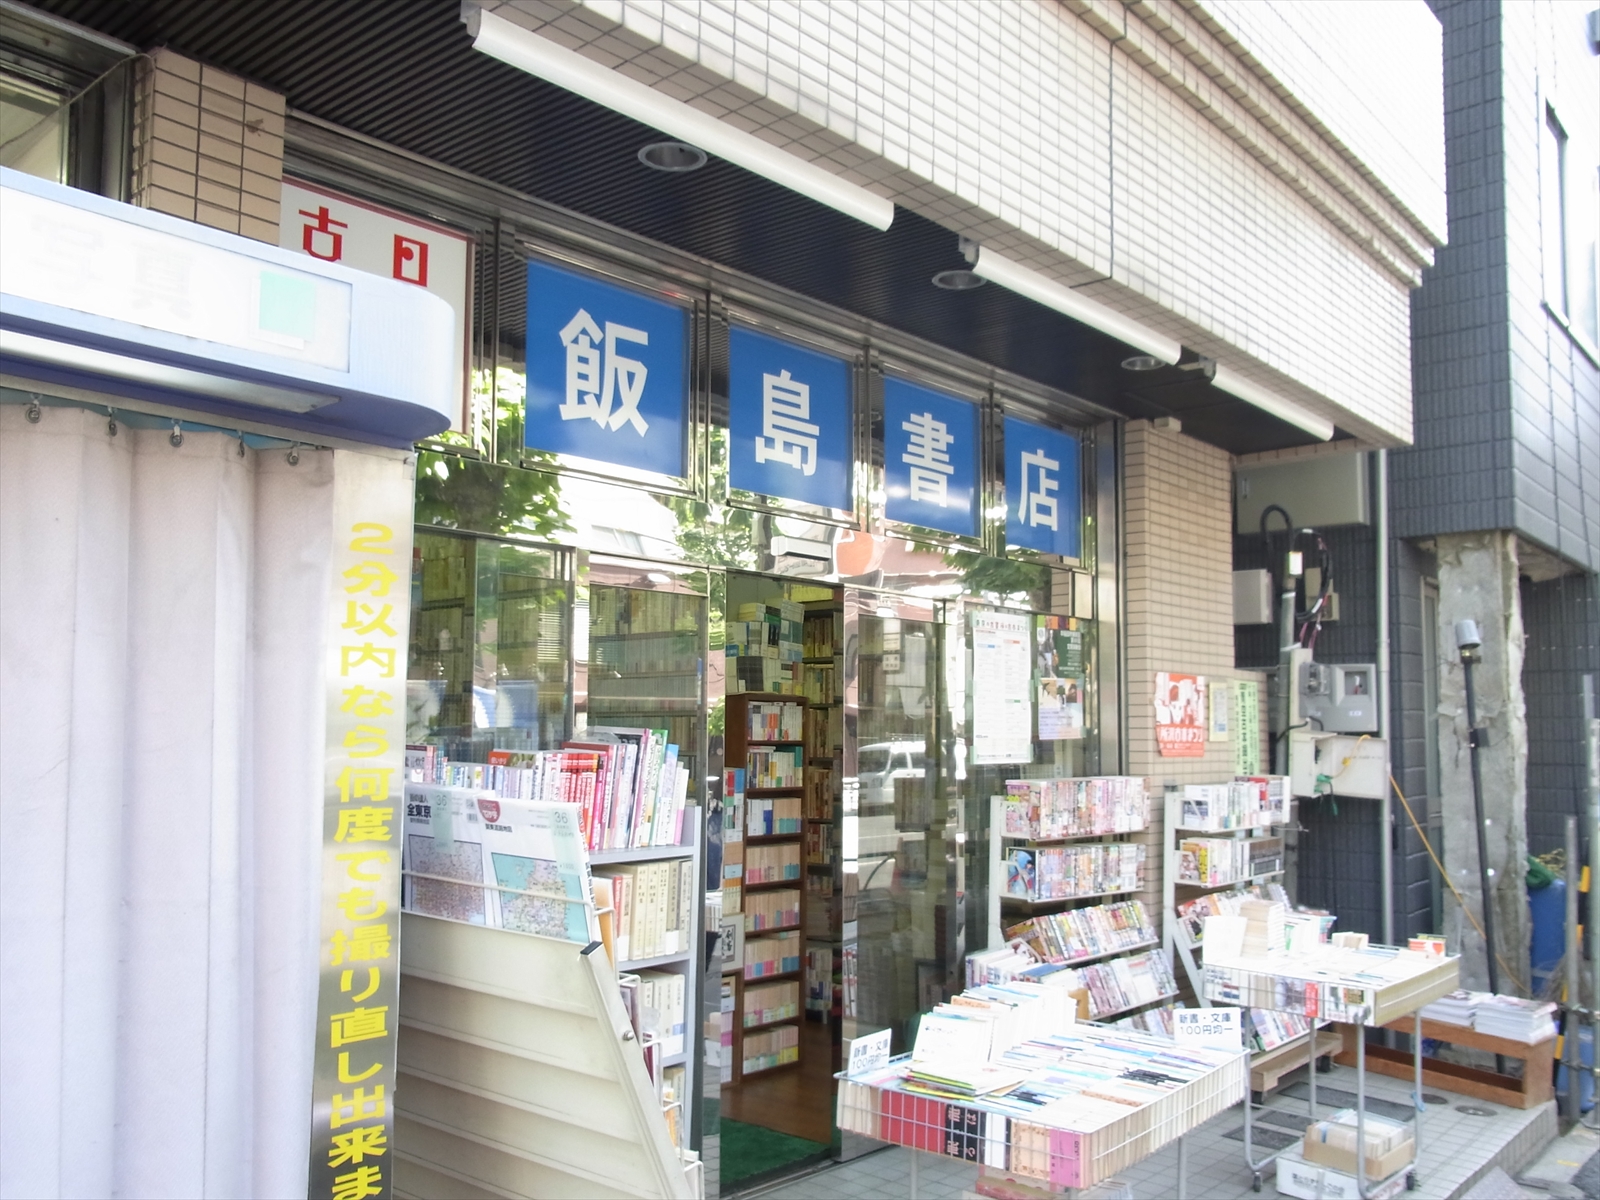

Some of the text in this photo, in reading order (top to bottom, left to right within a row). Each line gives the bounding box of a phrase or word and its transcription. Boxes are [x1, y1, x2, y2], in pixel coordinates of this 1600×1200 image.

[559, 308, 1060, 533] 飯島書店
[407, 803, 432, 819] 全東京
[554, 811, 569, 824] 36
[1179, 1012, 1231, 1024] 新書・文庫
[1180, 1024, 1233, 1035] 100円均一
[852, 1053, 888, 1069] 100円均一
